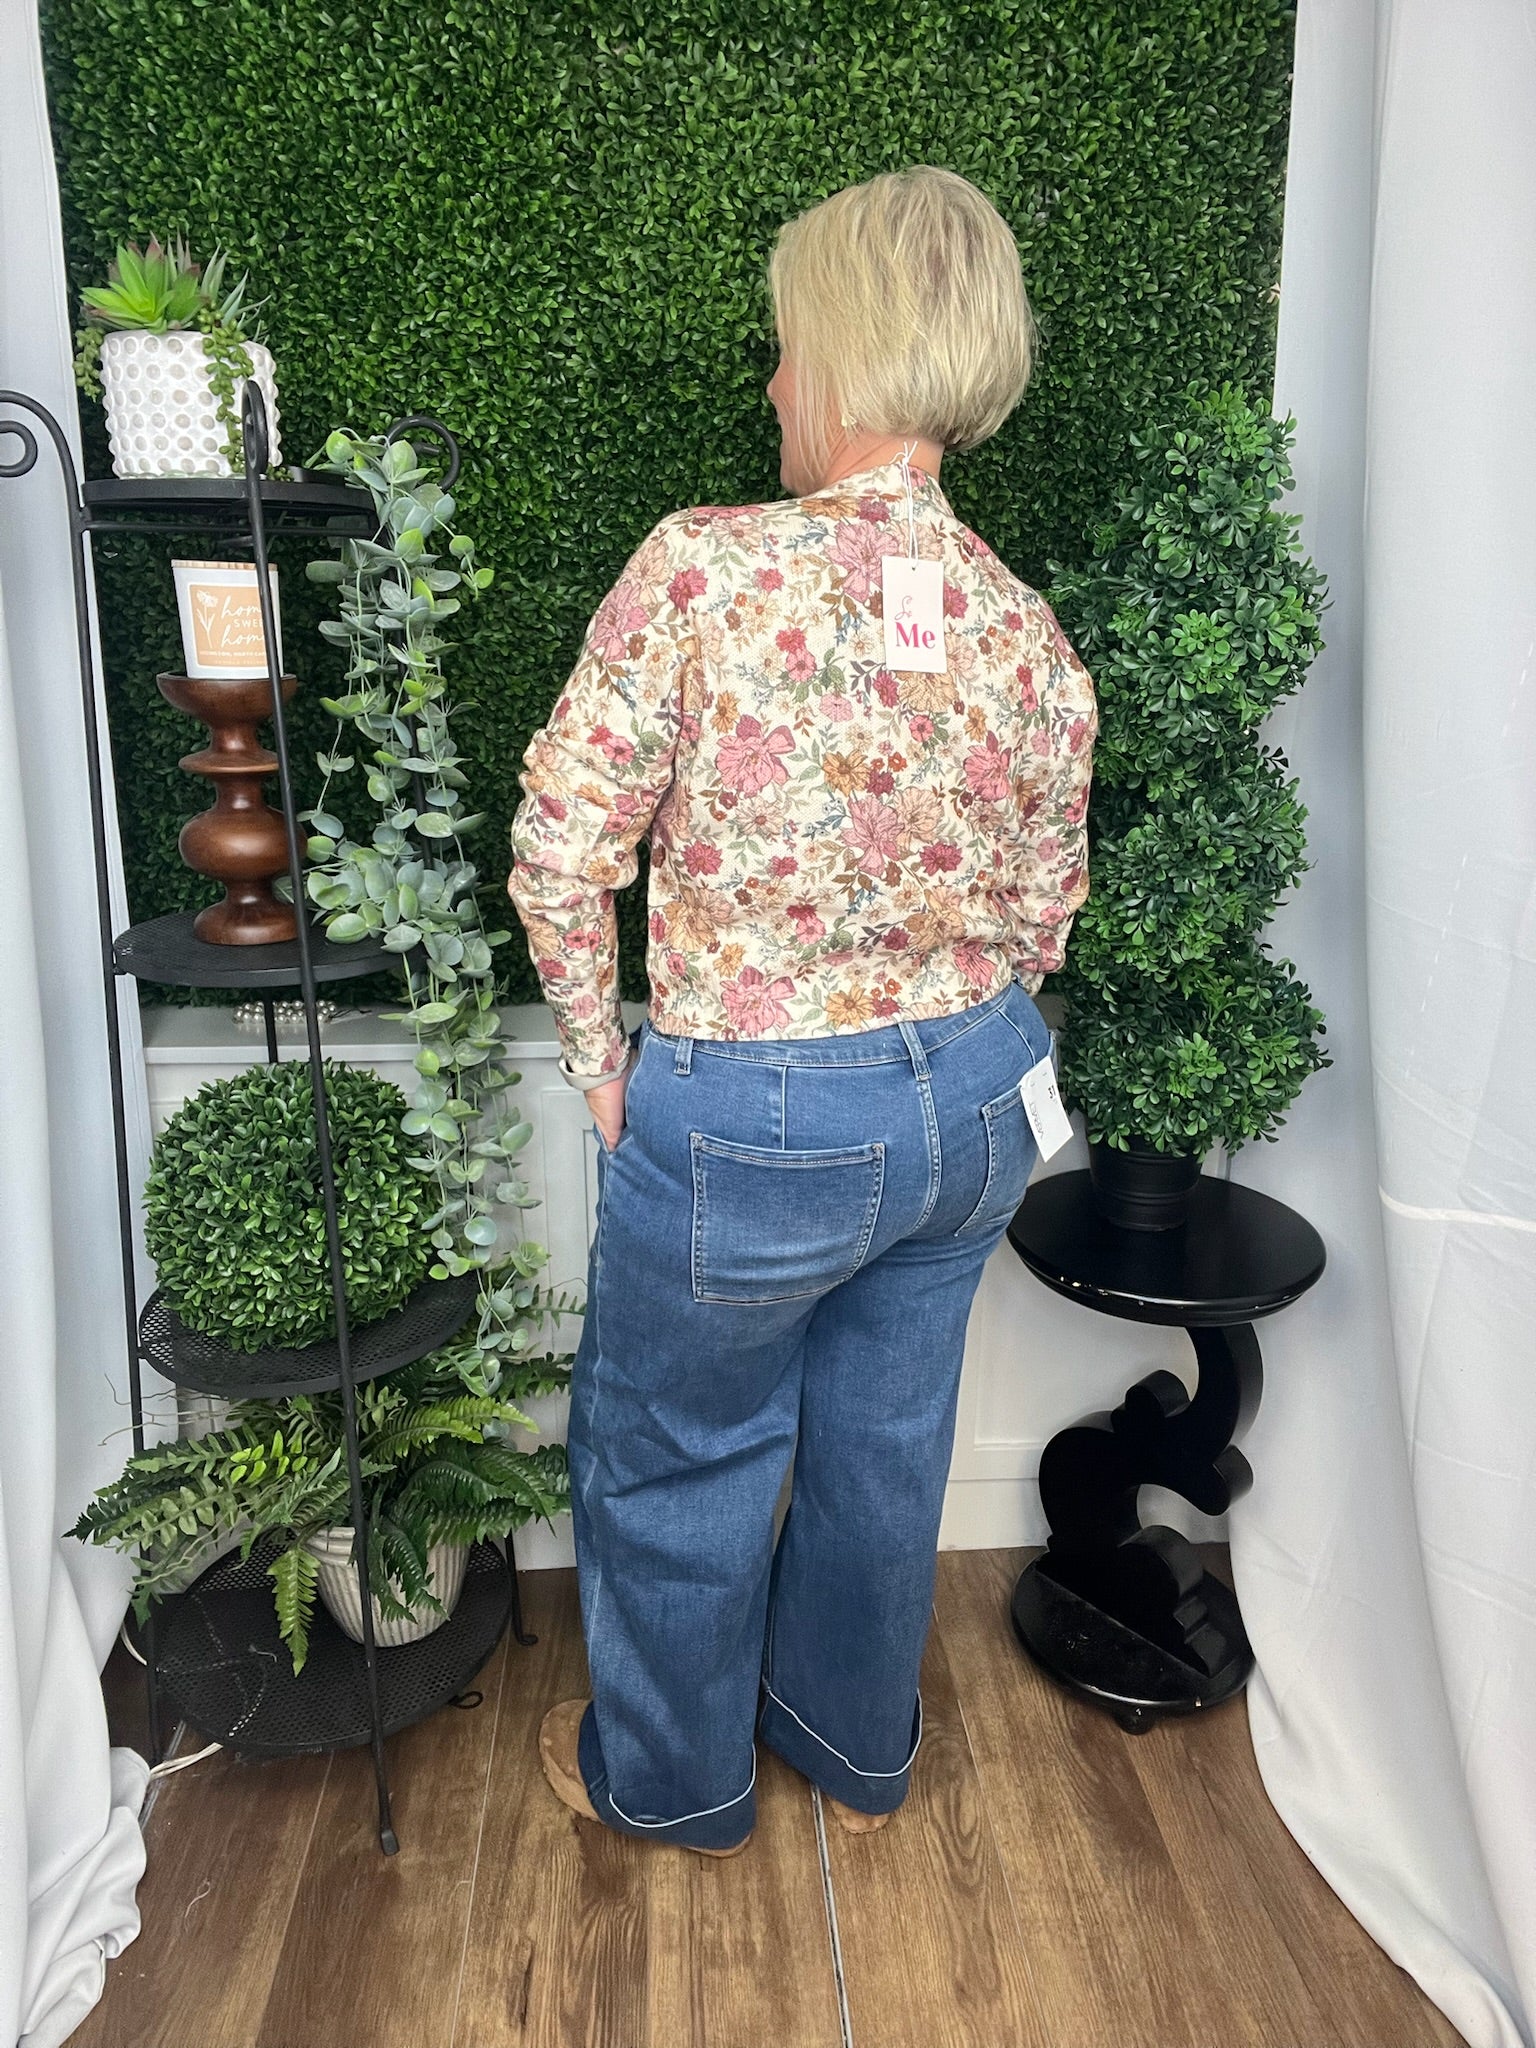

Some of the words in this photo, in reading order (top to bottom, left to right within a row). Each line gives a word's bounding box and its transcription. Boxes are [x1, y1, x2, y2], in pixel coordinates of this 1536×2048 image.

[221, 595, 262, 618] hom
[233, 618, 263, 628] SWEE
[221, 624, 264, 648] hom
[895, 621, 936, 650] Me
